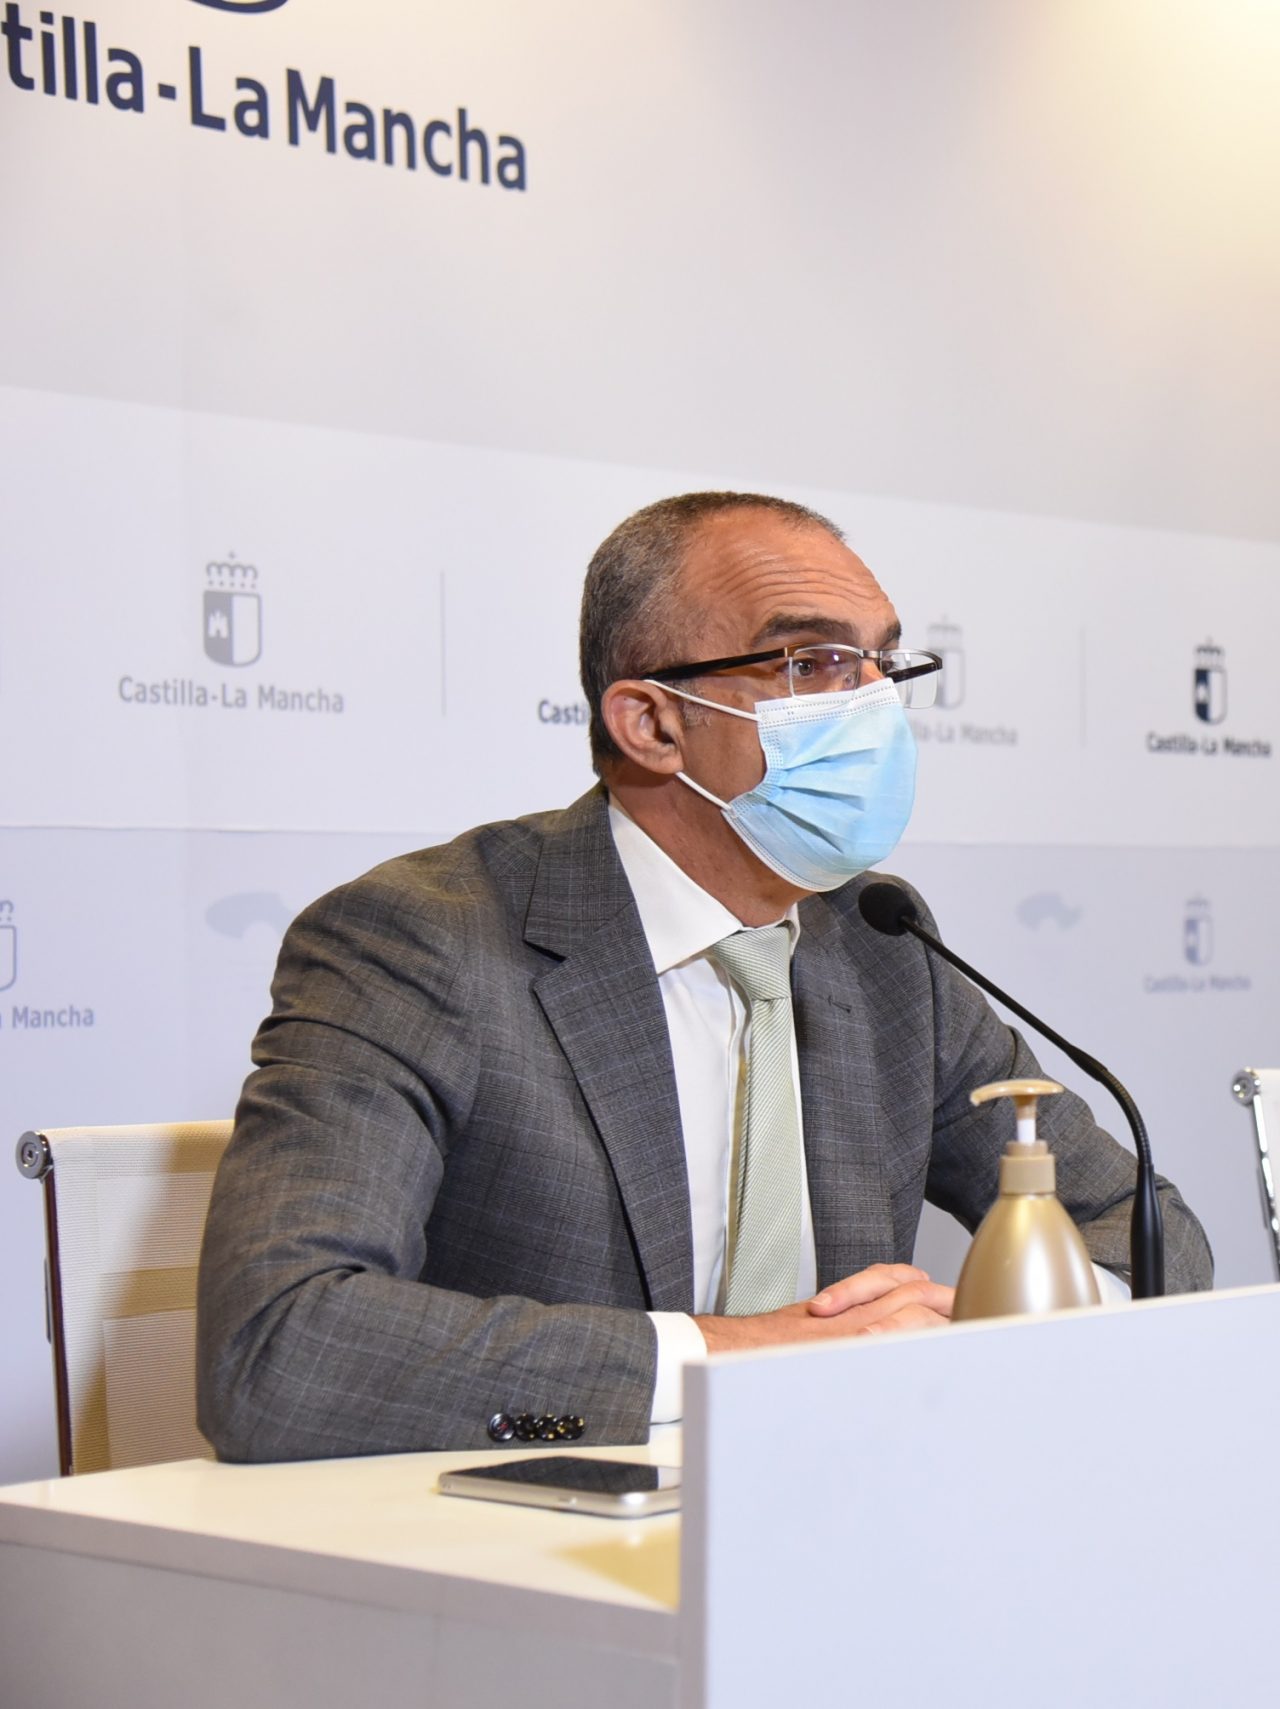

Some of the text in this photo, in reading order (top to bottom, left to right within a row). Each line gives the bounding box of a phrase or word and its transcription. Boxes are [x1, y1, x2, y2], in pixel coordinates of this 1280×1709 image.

[1, 2, 529, 192] tilla-La Mancha
[118, 675, 345, 714] Castilla-La Mancha
[1145, 731, 1272, 758] Castilla-La Mancha
[12, 1004, 95, 1029] Mancha
